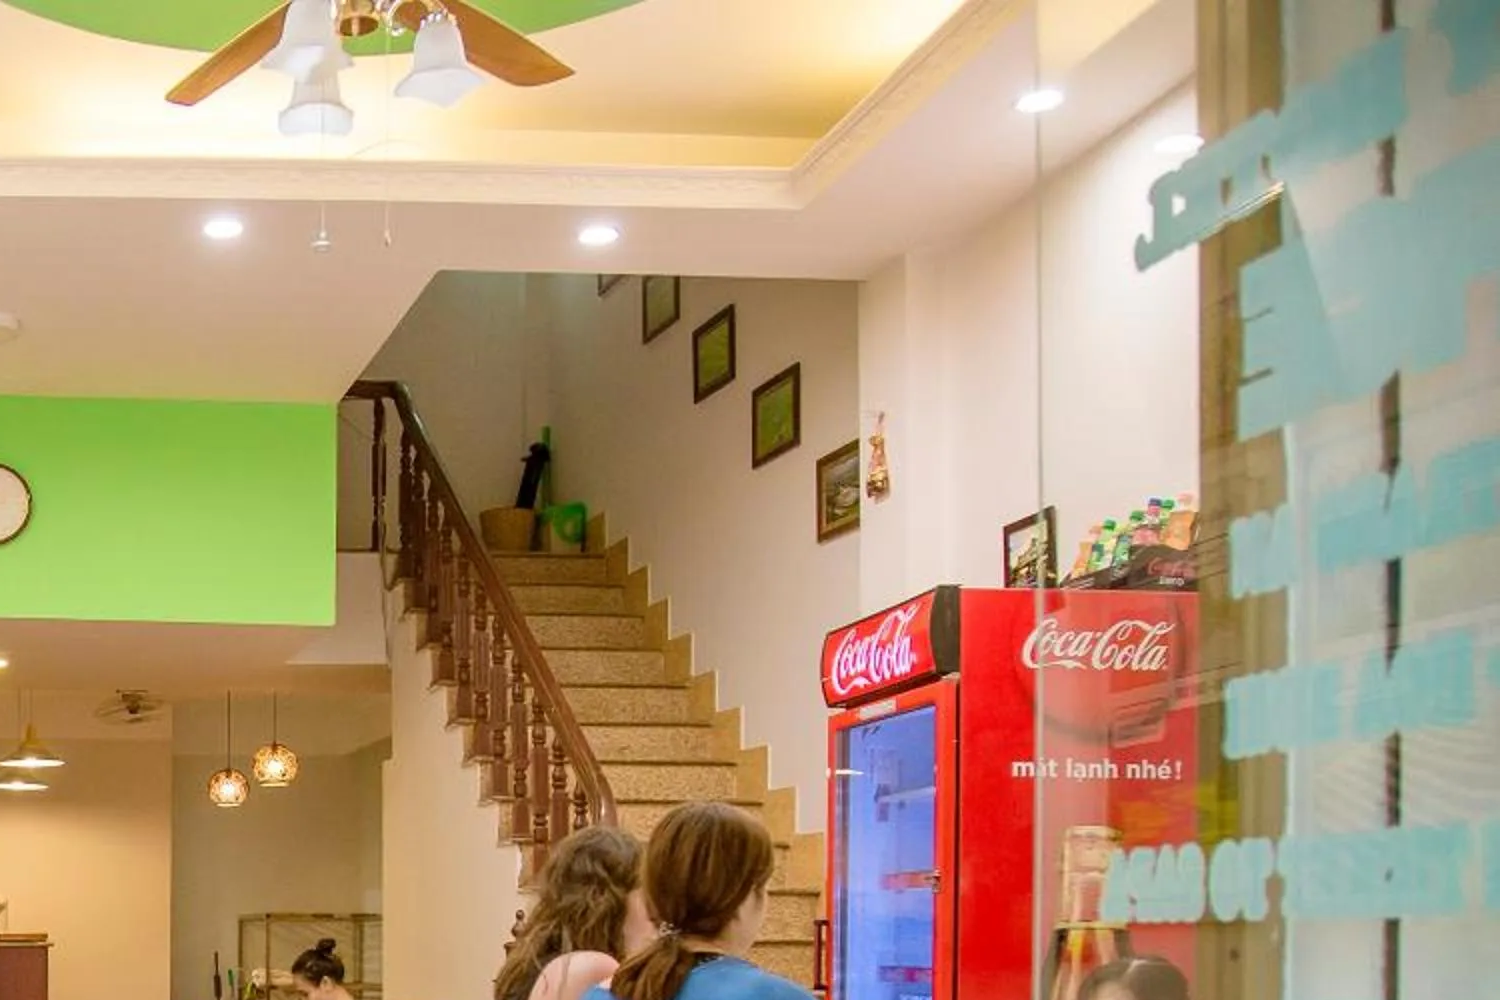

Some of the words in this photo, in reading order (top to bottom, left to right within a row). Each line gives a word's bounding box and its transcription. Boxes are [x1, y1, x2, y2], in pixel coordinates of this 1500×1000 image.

[832, 601, 921, 694] Coca-Cola
[1022, 618, 1176, 671] Coca-Cola
[1066, 758, 1118, 783] lạnh
